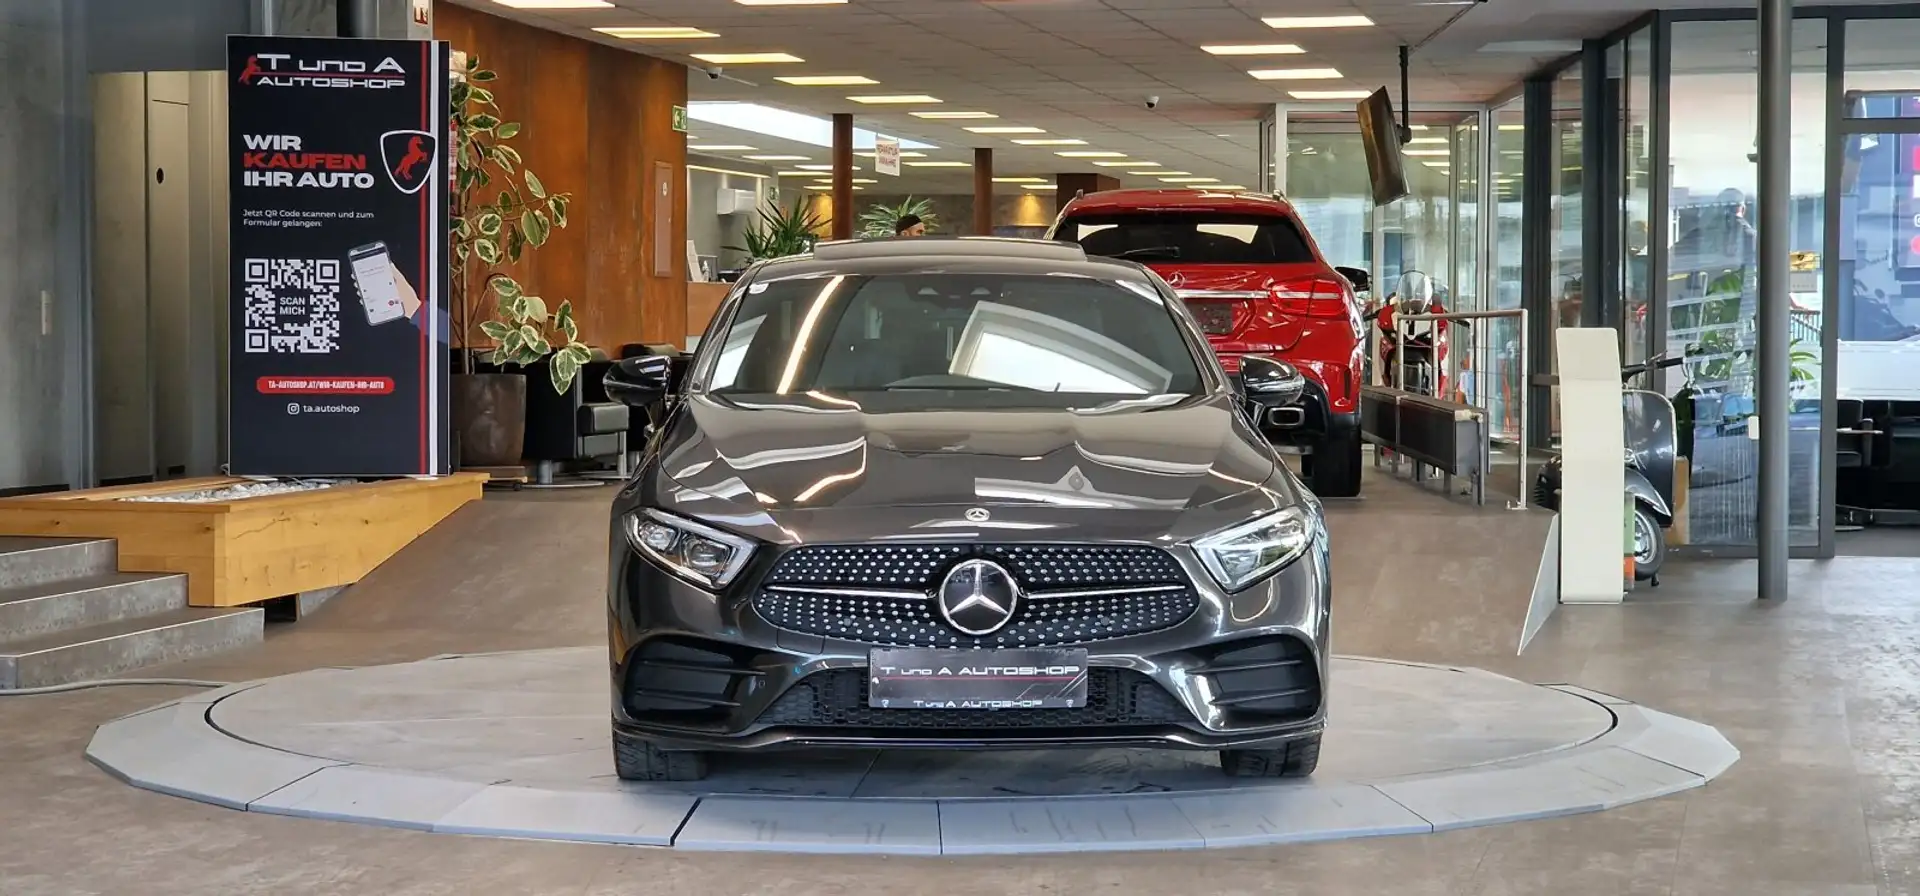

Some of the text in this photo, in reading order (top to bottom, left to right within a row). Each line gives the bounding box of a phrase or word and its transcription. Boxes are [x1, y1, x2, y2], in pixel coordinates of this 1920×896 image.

[257, 53, 291, 70] T
[372, 56, 406, 74] A
[256, 76, 406, 89] AUTOSHOP
[243, 134, 302, 151] WIR
[243, 152, 366, 170] KAUFEN
[243, 171, 375, 189] IHR AUTO
[242, 209, 263, 217] Jetzt
[264, 209, 278, 218] QR
[279, 209, 300, 218] Code
[338, 210, 354, 219] und
[243, 219, 323, 228] Formular gelangen:
[279, 297, 306, 306] SCAN
[279, 306, 306, 315] MICH
[303, 404, 360, 414] ta.autoshop
[880, 666, 896, 676] T
[937, 666, 953, 676] A
[958, 666, 1080, 676] AUTOSHOP
[913, 700, 925, 708] T
[945, 700, 957, 708] A
[961, 700, 1043, 708] AUTOSHOP
